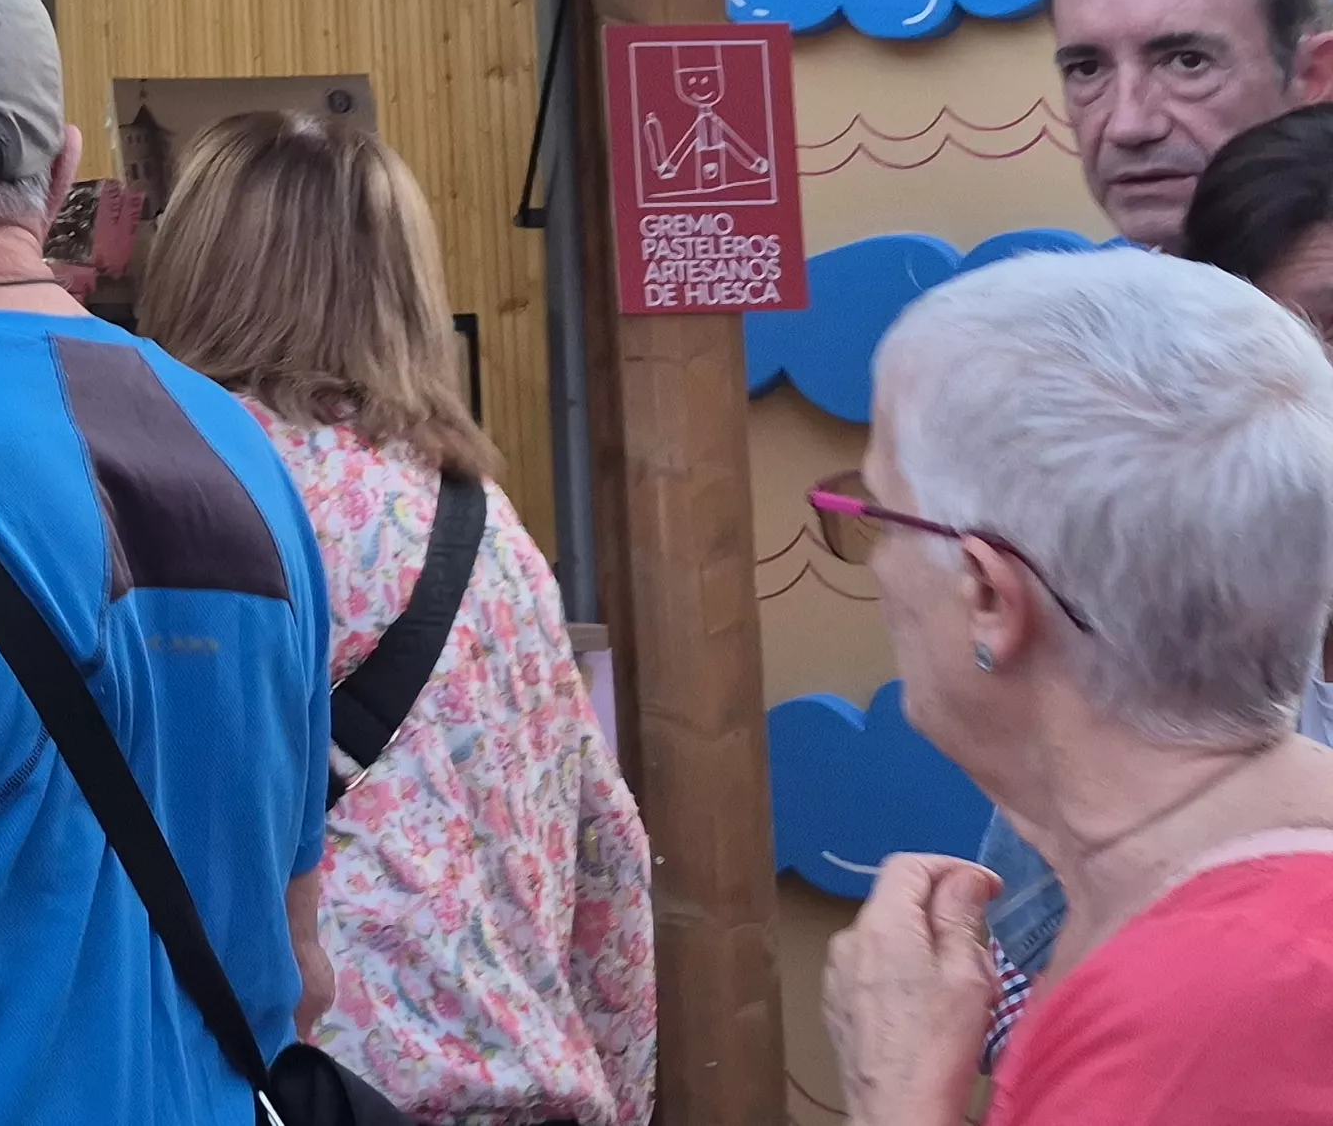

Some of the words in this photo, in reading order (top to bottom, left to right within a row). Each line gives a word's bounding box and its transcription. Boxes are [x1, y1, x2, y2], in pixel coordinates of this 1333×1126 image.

[639, 212, 735, 237] GREMIO
[641, 234, 781, 260] PASTELEROS
[642, 258, 782, 284] ARTESANOS
[644, 283, 678, 306] DE
[683, 281, 782, 306] HUESCA
